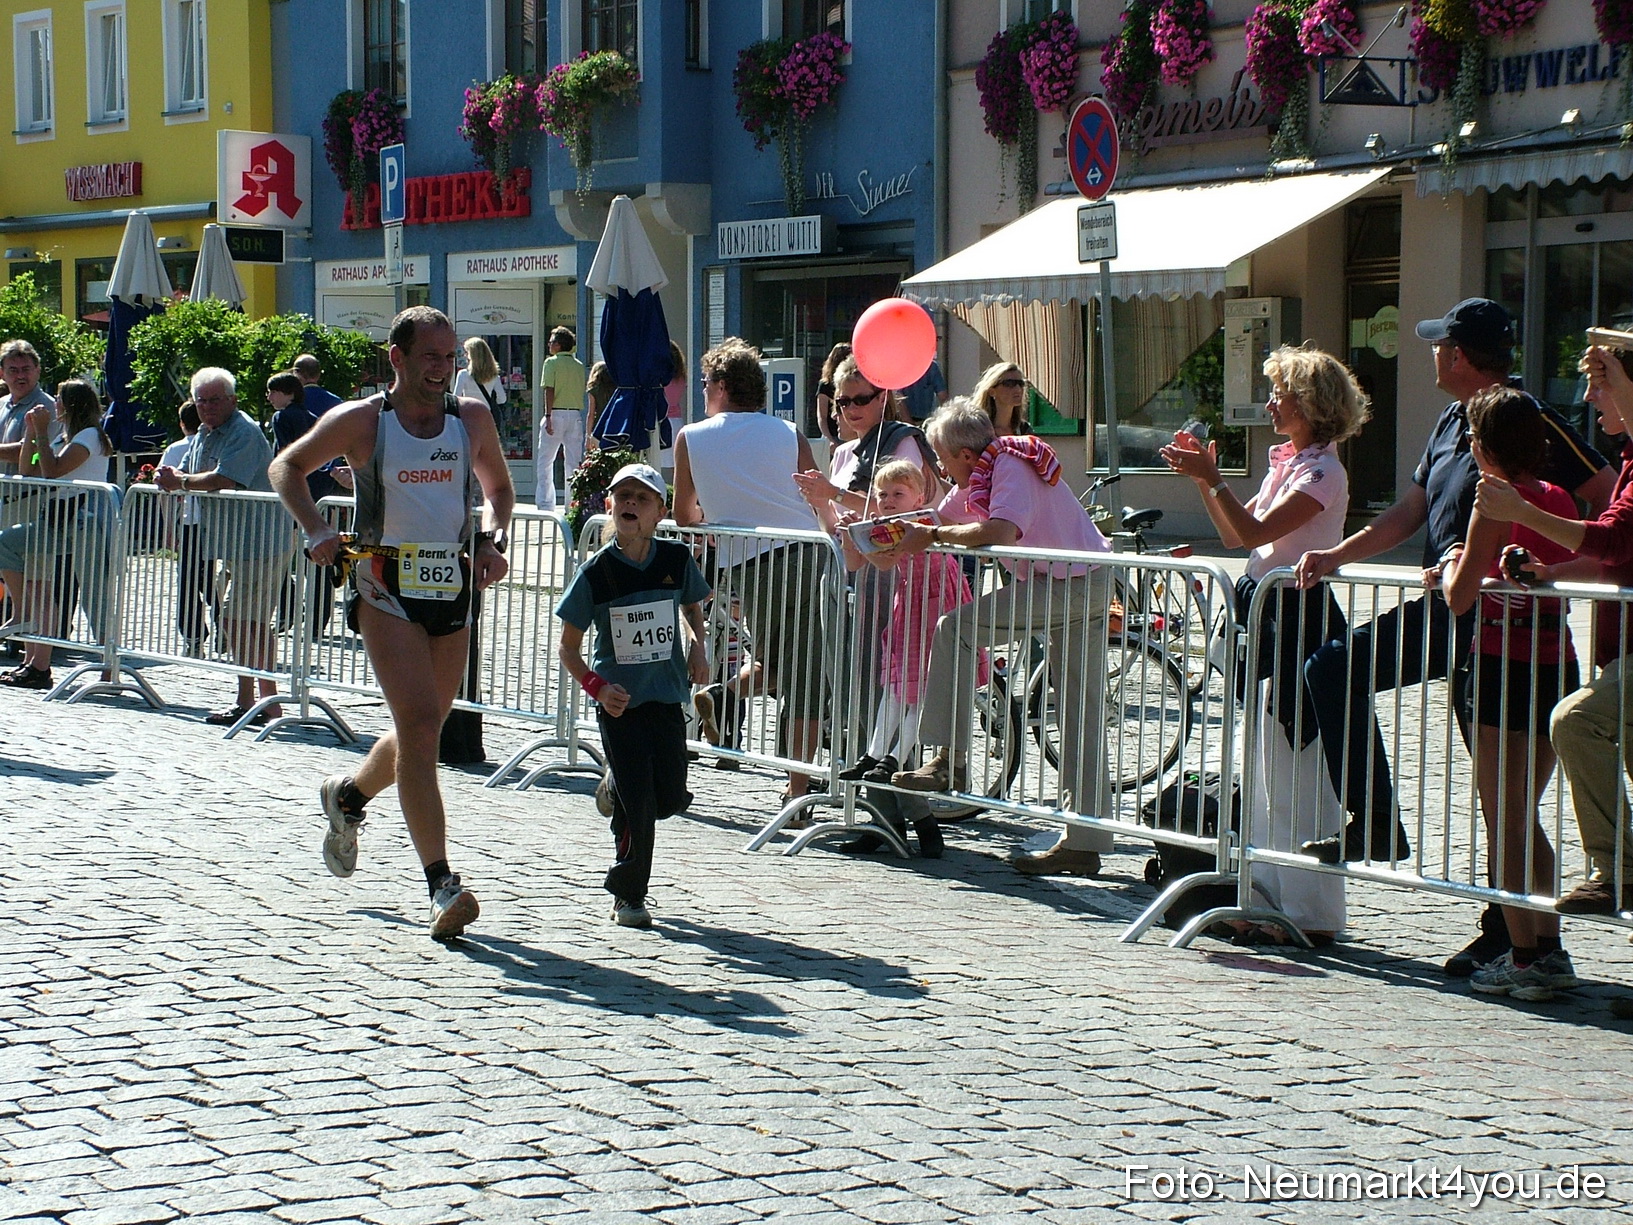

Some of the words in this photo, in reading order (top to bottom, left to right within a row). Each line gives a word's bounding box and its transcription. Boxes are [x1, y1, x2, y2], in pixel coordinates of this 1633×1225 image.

[385, 156, 399, 212] P
[815, 172, 835, 199] DER
[857, 165, 917, 217] Sinner
[340, 168, 530, 230] APTHEKE
[720, 223, 781, 255] KONDITOREI
[787, 220, 818, 250] WITTL
[466, 257, 508, 273] RATHAUS
[511, 254, 558, 271] APOTHEKE
[331, 265, 368, 281] RATHAUS
[778, 380, 791, 403] P
[440, 451, 459, 461] asics
[397, 469, 452, 484] OSRAM
[403, 560, 412, 570] B
[420, 566, 453, 583] 862
[627, 610, 655, 624] Björn
[616, 629, 622, 639] J
[632, 625, 673, 647] 4166
